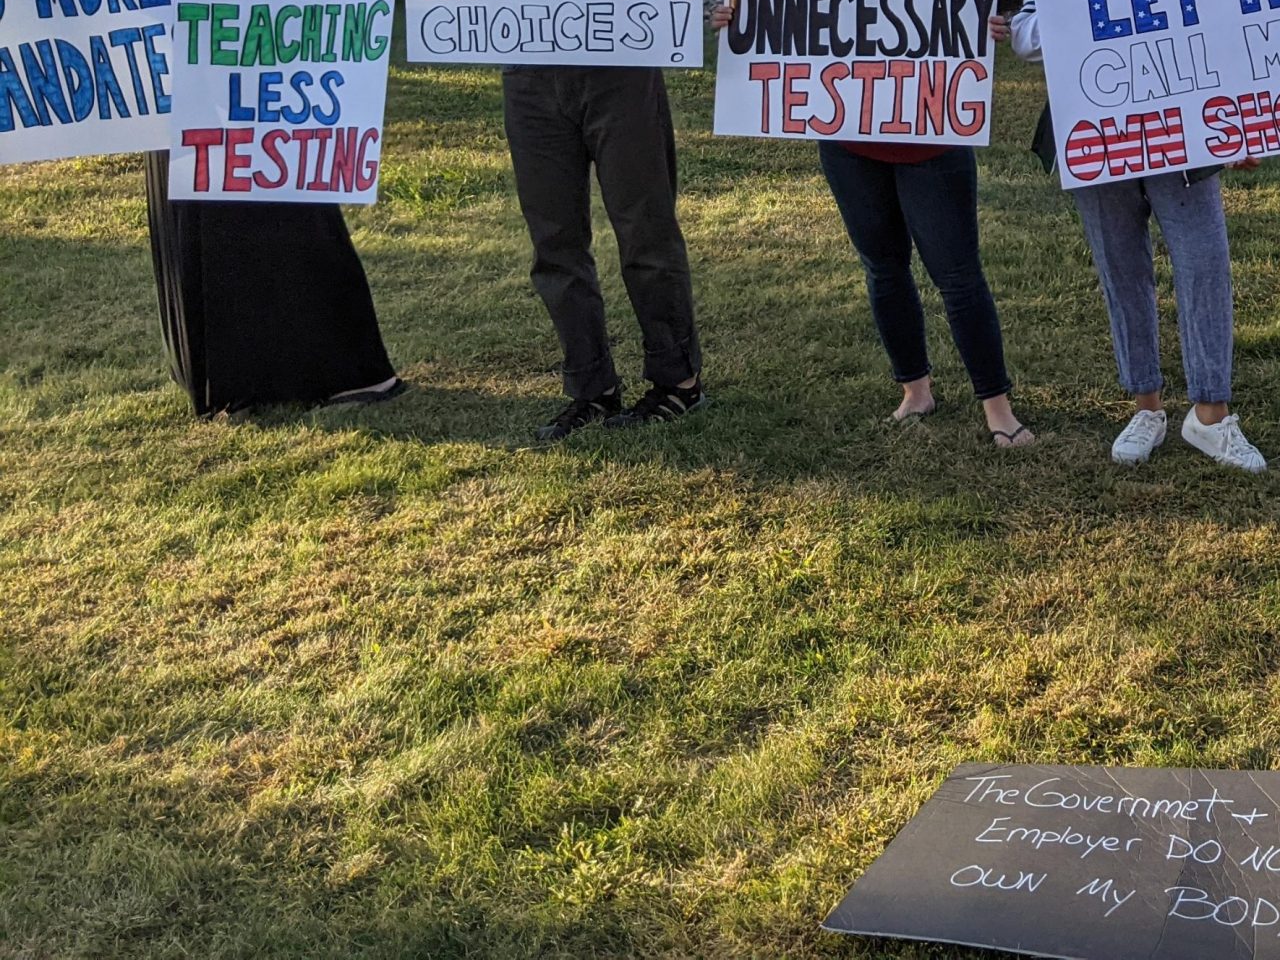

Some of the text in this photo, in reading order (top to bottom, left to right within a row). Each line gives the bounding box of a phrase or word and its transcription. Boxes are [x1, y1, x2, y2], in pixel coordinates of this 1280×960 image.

[177, 0, 391, 67] TEACHING
[420, 1, 691, 62] CHOICES!
[0, 23, 174, 132] ANDATE
[228, 70, 345, 124] LESS
[749, 60, 988, 137] TESTING
[1079, 32, 1220, 108] CALL
[182, 127, 379, 193] TESTING
[1065, 106, 1188, 181] OWN
[963, 775, 1020, 805] The
[1024, 777, 1234, 823] Governmet
[975, 816, 1143, 859] Employer
[1166, 834, 1222, 864] DO
[950, 864, 1048, 893] OWN
